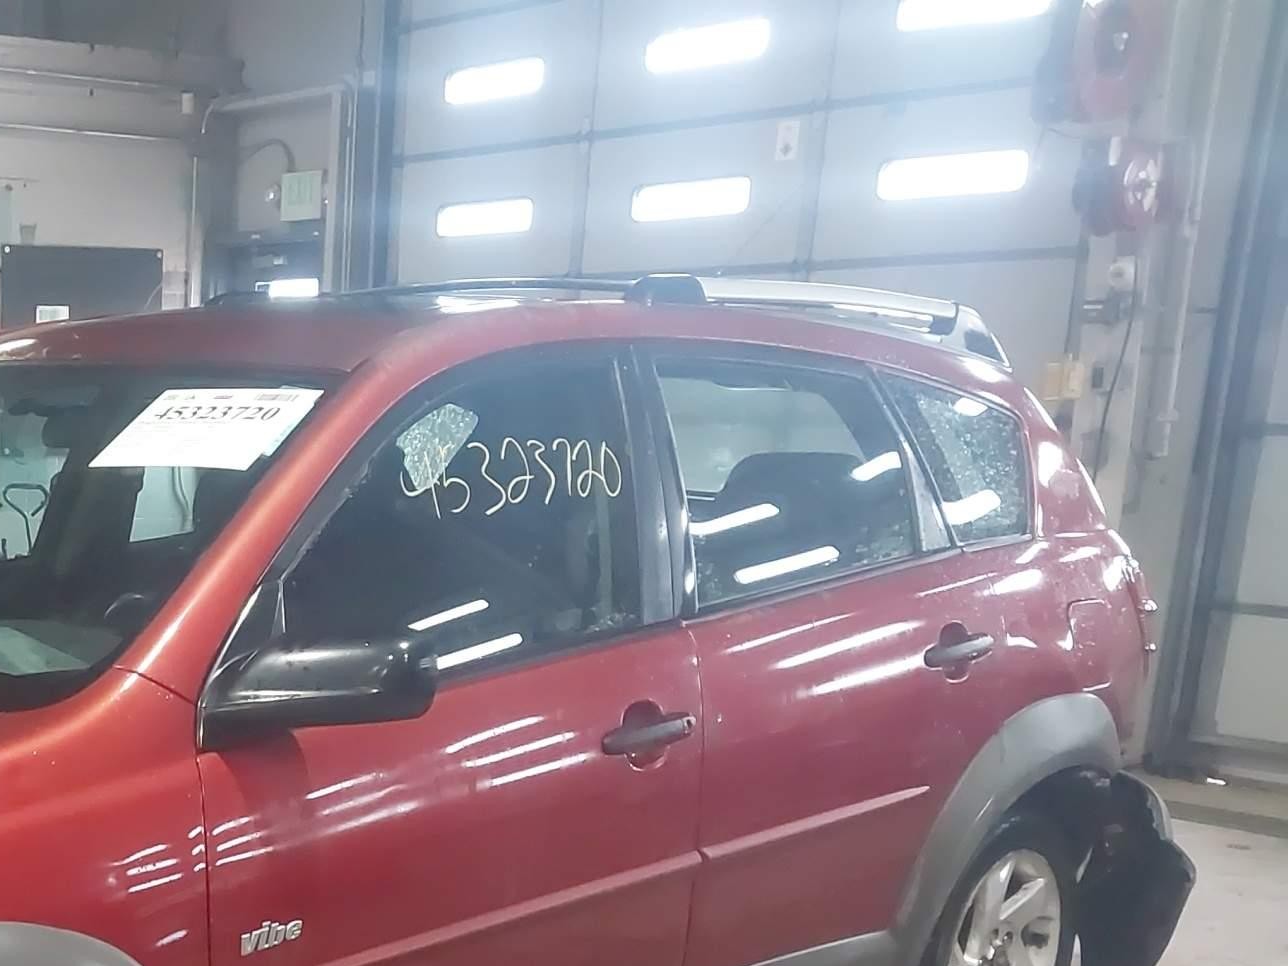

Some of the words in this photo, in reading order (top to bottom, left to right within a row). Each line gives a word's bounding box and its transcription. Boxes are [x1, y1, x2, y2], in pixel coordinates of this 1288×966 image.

[154, 405, 281, 421] 45323720
[400, 437, 622, 519] 45323720
[241, 919, 303, 956] vibe
